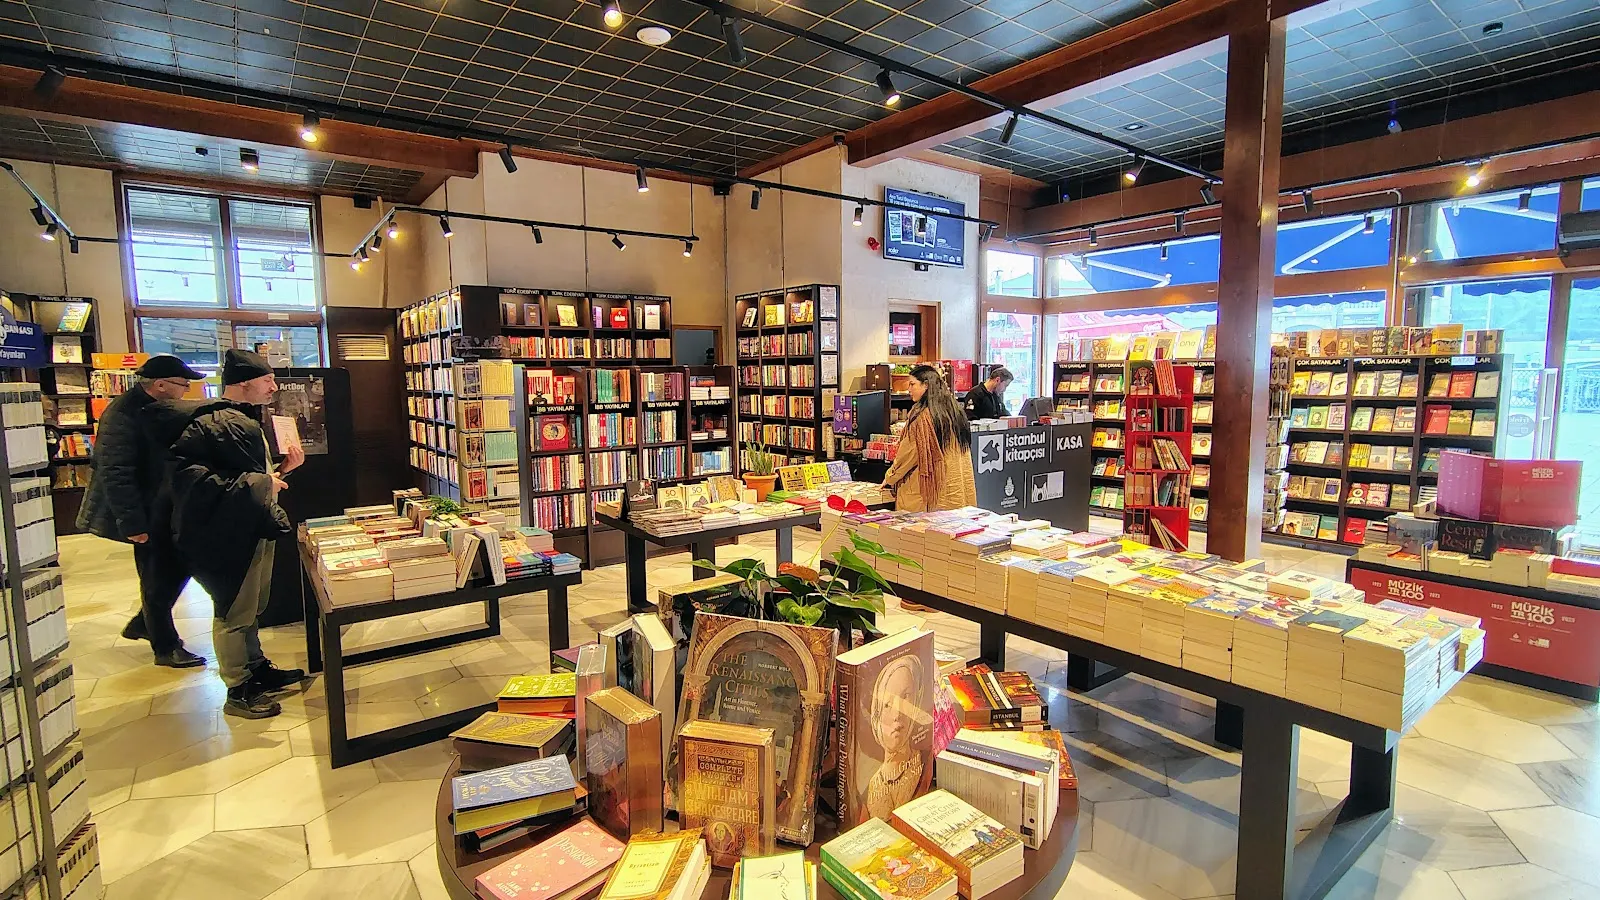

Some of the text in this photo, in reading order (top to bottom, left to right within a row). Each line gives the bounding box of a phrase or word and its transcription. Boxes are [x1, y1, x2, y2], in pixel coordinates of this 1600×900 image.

[1006, 432, 1046, 448] istanbul
[1056, 436, 1084, 451] KASA
[1006, 448, 1045, 462] kitapçısı
[1388, 579, 1424, 593] MÜZİK
[1401, 589, 1424, 600] 100
[1511, 601, 1555, 617] MÜZİK
[1527, 612, 1555, 625] 100
[722, 652, 748, 666] THE
[840, 684, 848, 714] What
[839, 717, 848, 745] Great
[956, 744, 1000, 758] ORHAN PAMUK
[700, 762, 744, 774] COMPLETE
[837, 750, 848, 800] Paintings
[706, 772, 737, 782] WORKS
[694, 782, 748, 806] WILLIAM
[686, 799, 758, 824] SHAKESPEARE
[836, 803, 848, 822] Say
[552, 836, 599, 870] Persuasion
[496, 882, 518, 898] AUSTEN
[506, 880, 522, 892] JANE
